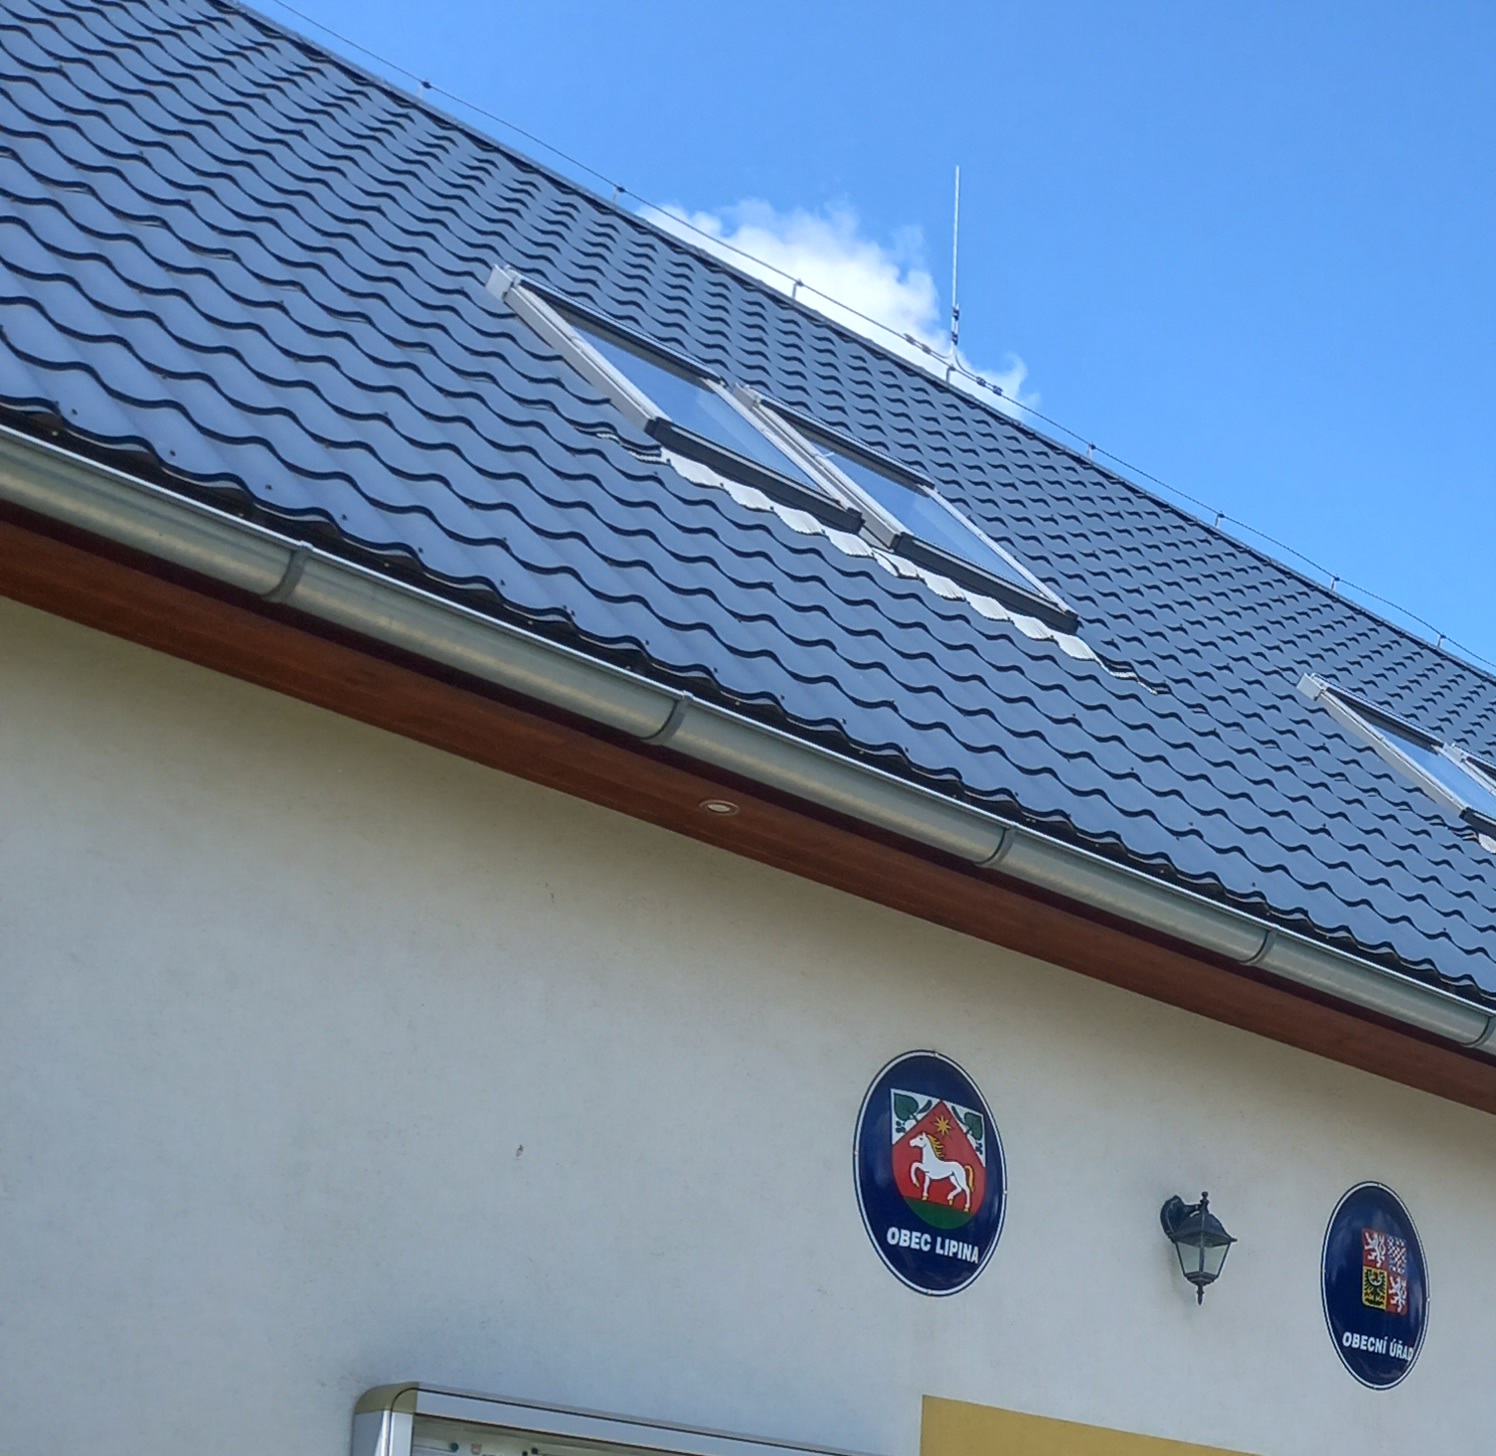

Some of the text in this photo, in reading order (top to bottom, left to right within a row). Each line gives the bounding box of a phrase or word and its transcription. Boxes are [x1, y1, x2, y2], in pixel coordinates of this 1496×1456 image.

[887, 1226, 980, 1264] OBEC LIPINA
[1342, 1331, 1414, 1361] OBECNÍ ÚŘAD
